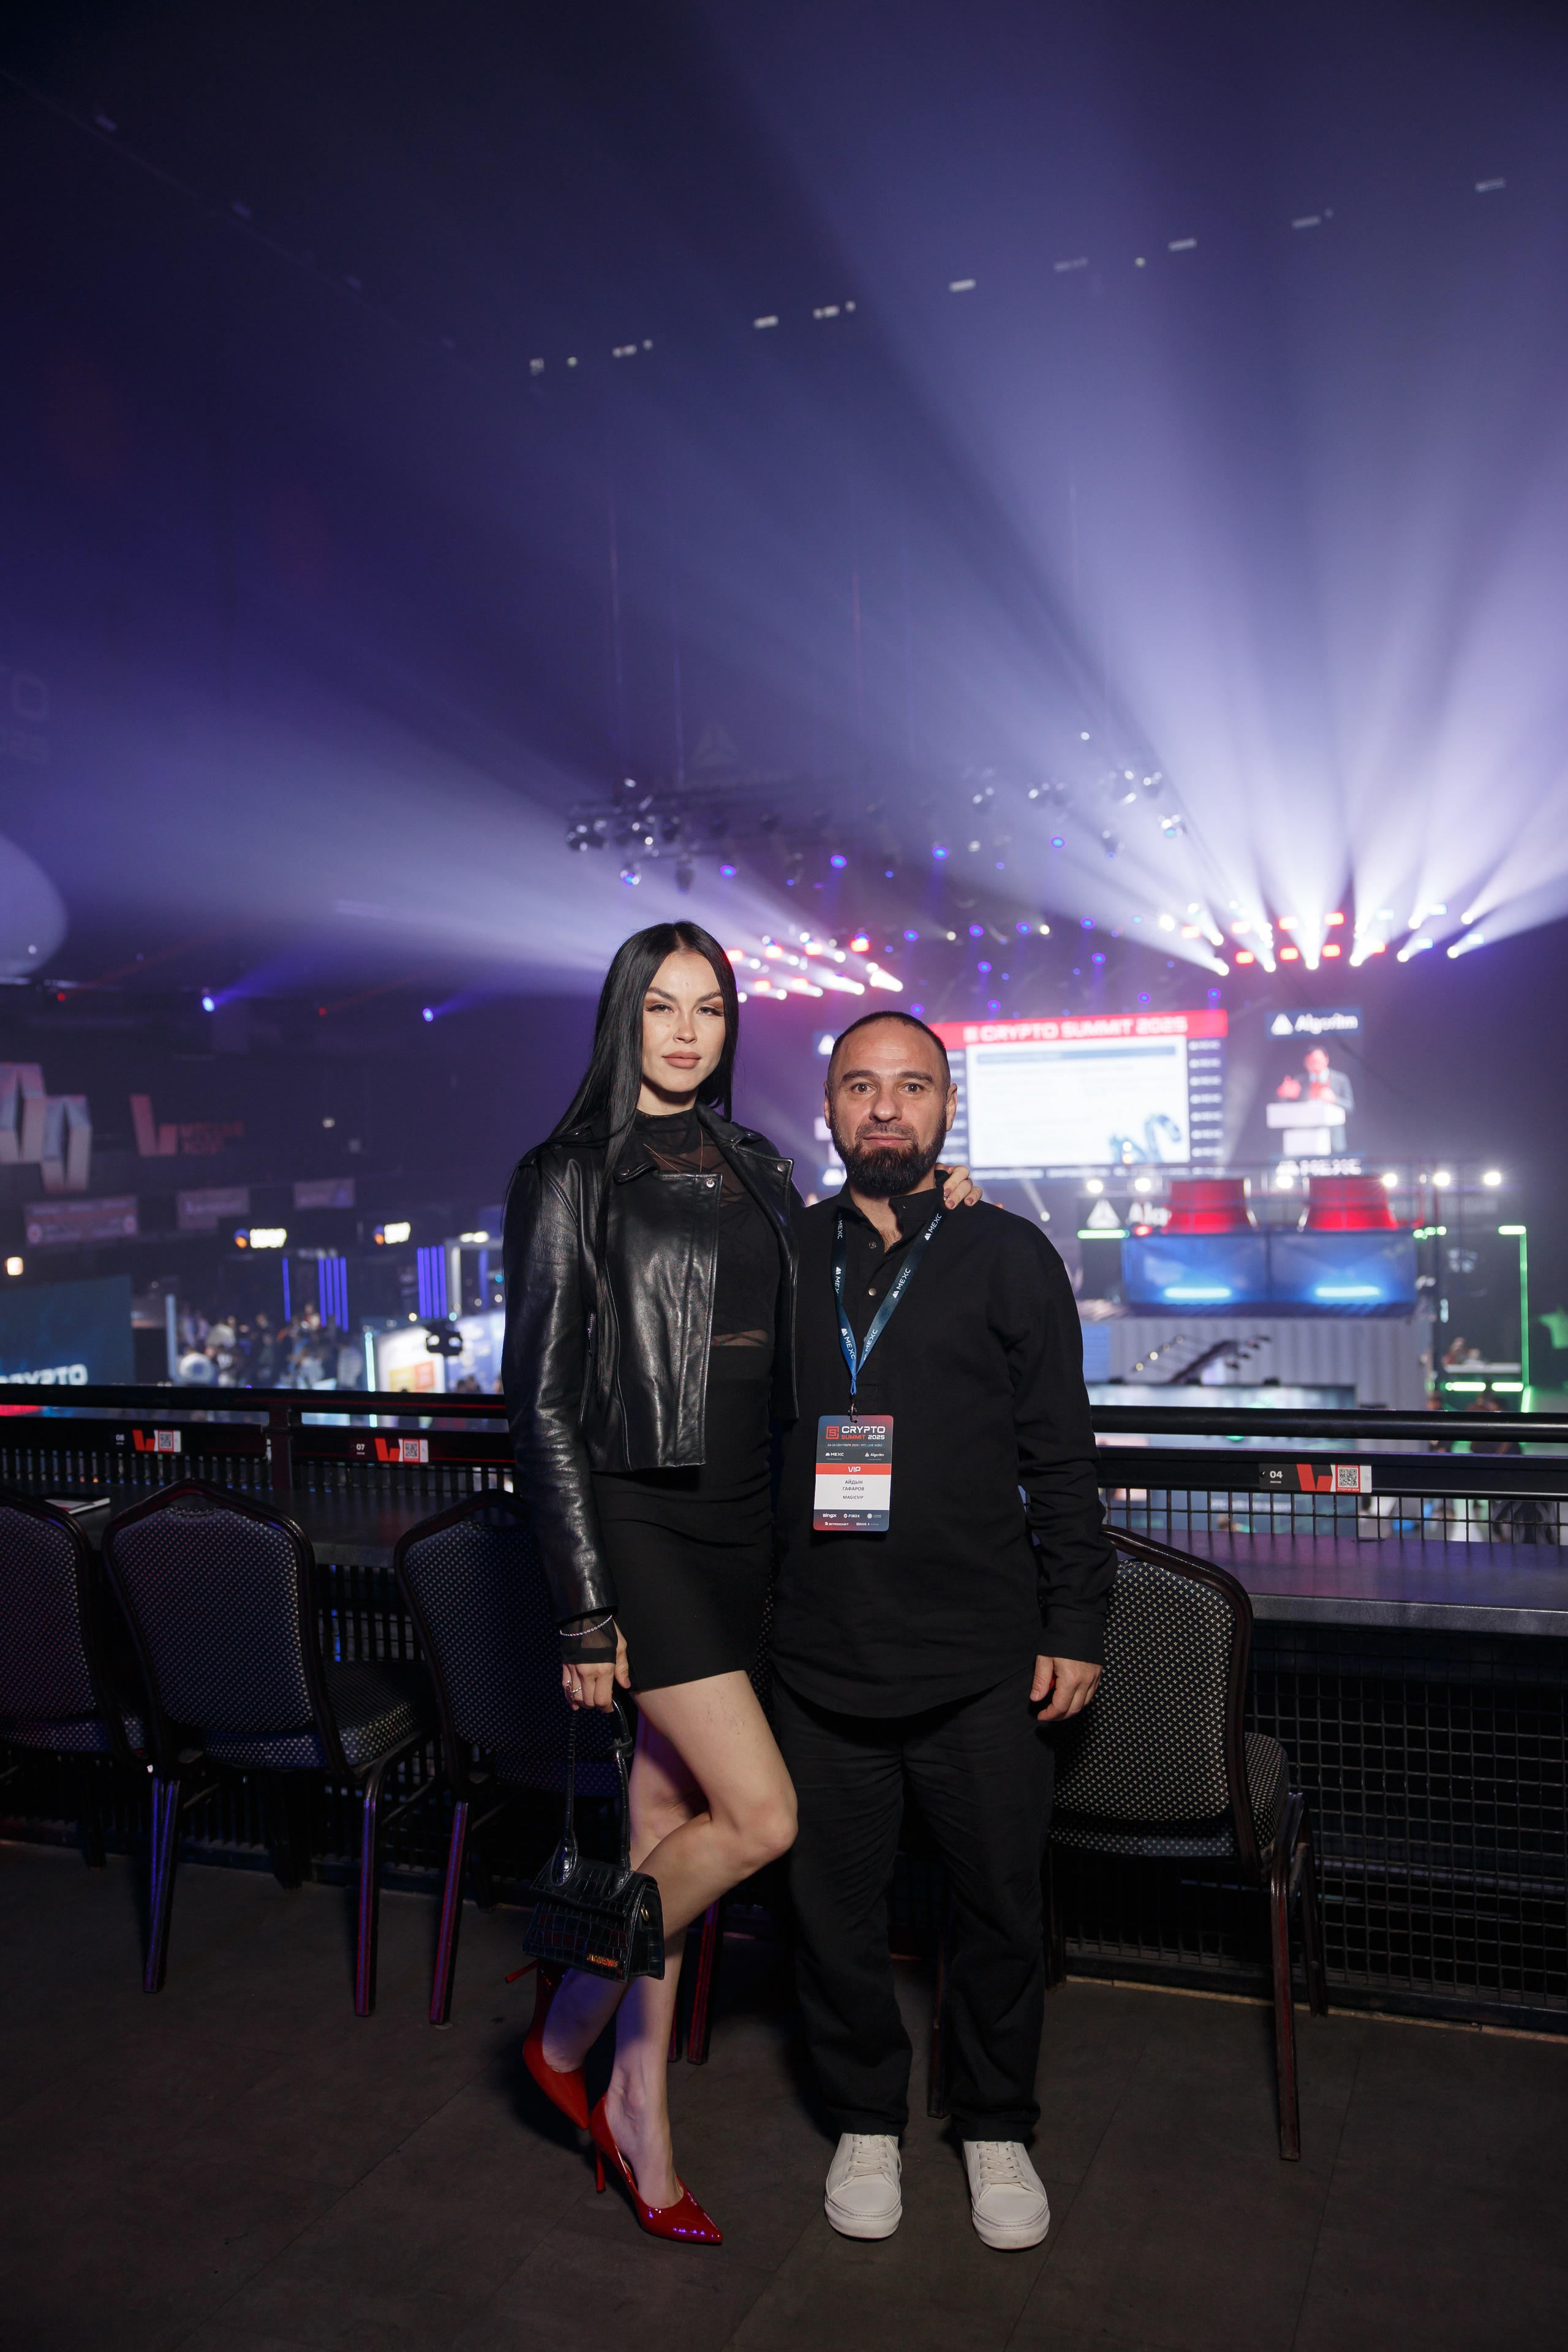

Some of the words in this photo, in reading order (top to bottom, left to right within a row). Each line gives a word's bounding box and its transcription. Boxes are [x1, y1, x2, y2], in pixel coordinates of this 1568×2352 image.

[980, 1022, 1059, 1042] CRYPTO
[1061, 1018, 1135, 1039] SUMMIT
[1136, 1016, 1188, 1036] 2025
[928, 1213, 942, 1233] MEXC
[896, 1268, 911, 1291] MEXC
[844, 1336, 856, 1359] MEXC
[865, 1329, 878, 1352] MEXC
